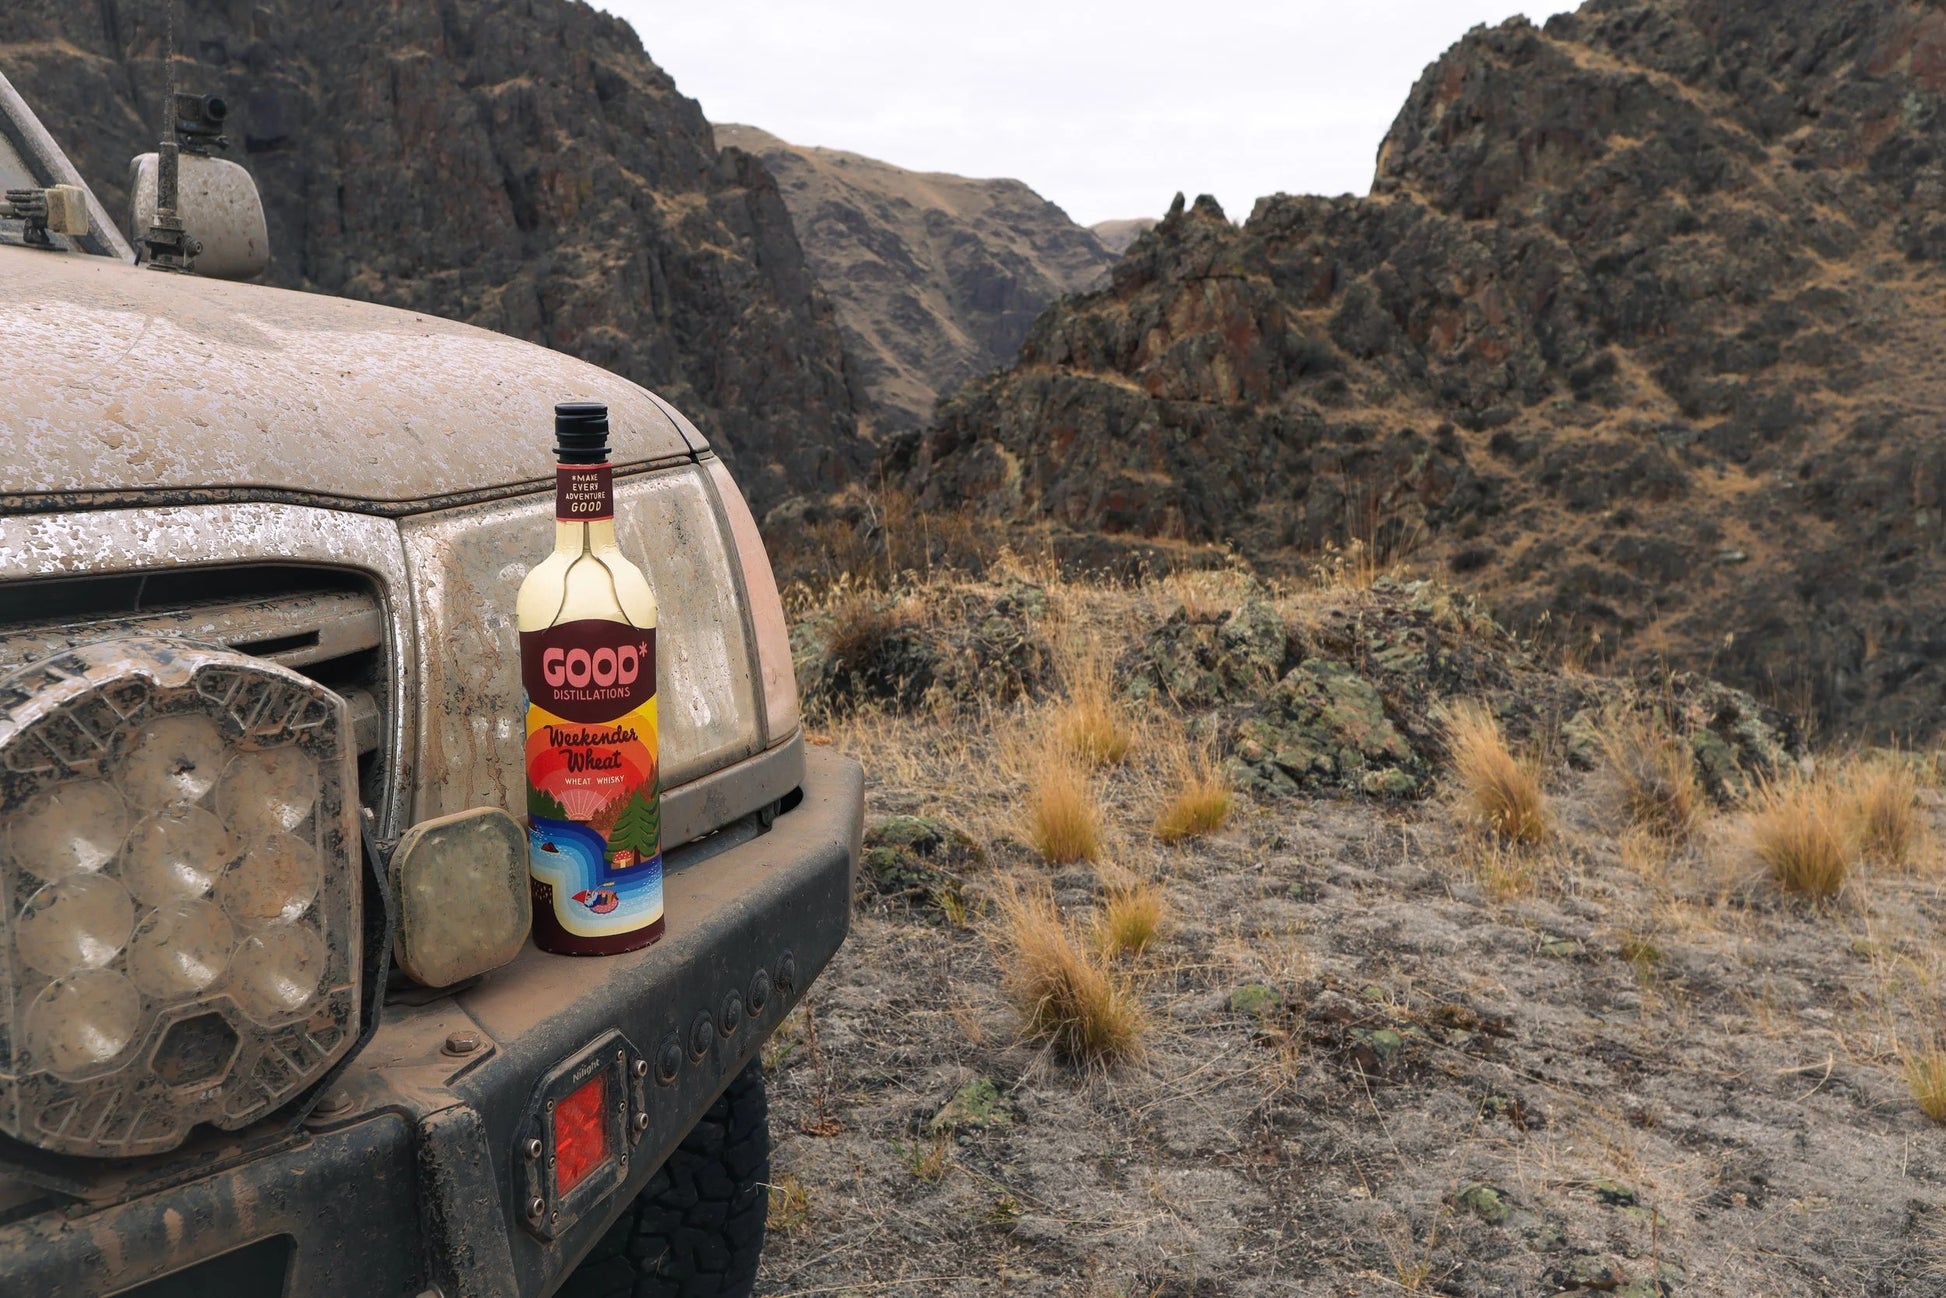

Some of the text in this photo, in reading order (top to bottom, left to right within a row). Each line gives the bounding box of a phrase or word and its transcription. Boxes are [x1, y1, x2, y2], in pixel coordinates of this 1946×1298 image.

[572, 482, 599, 491] EVERY
[565, 491, 606, 500] ADVENTURE
[571, 501, 602, 512] GOOD
[553, 686, 631, 701] DISTILLATIONS
[543, 724, 638, 748] Weekender
[559, 748, 622, 773] Wheat
[564, 775, 625, 786] WHEAT WHISKY
[572, 1058, 600, 1084] Nilight
